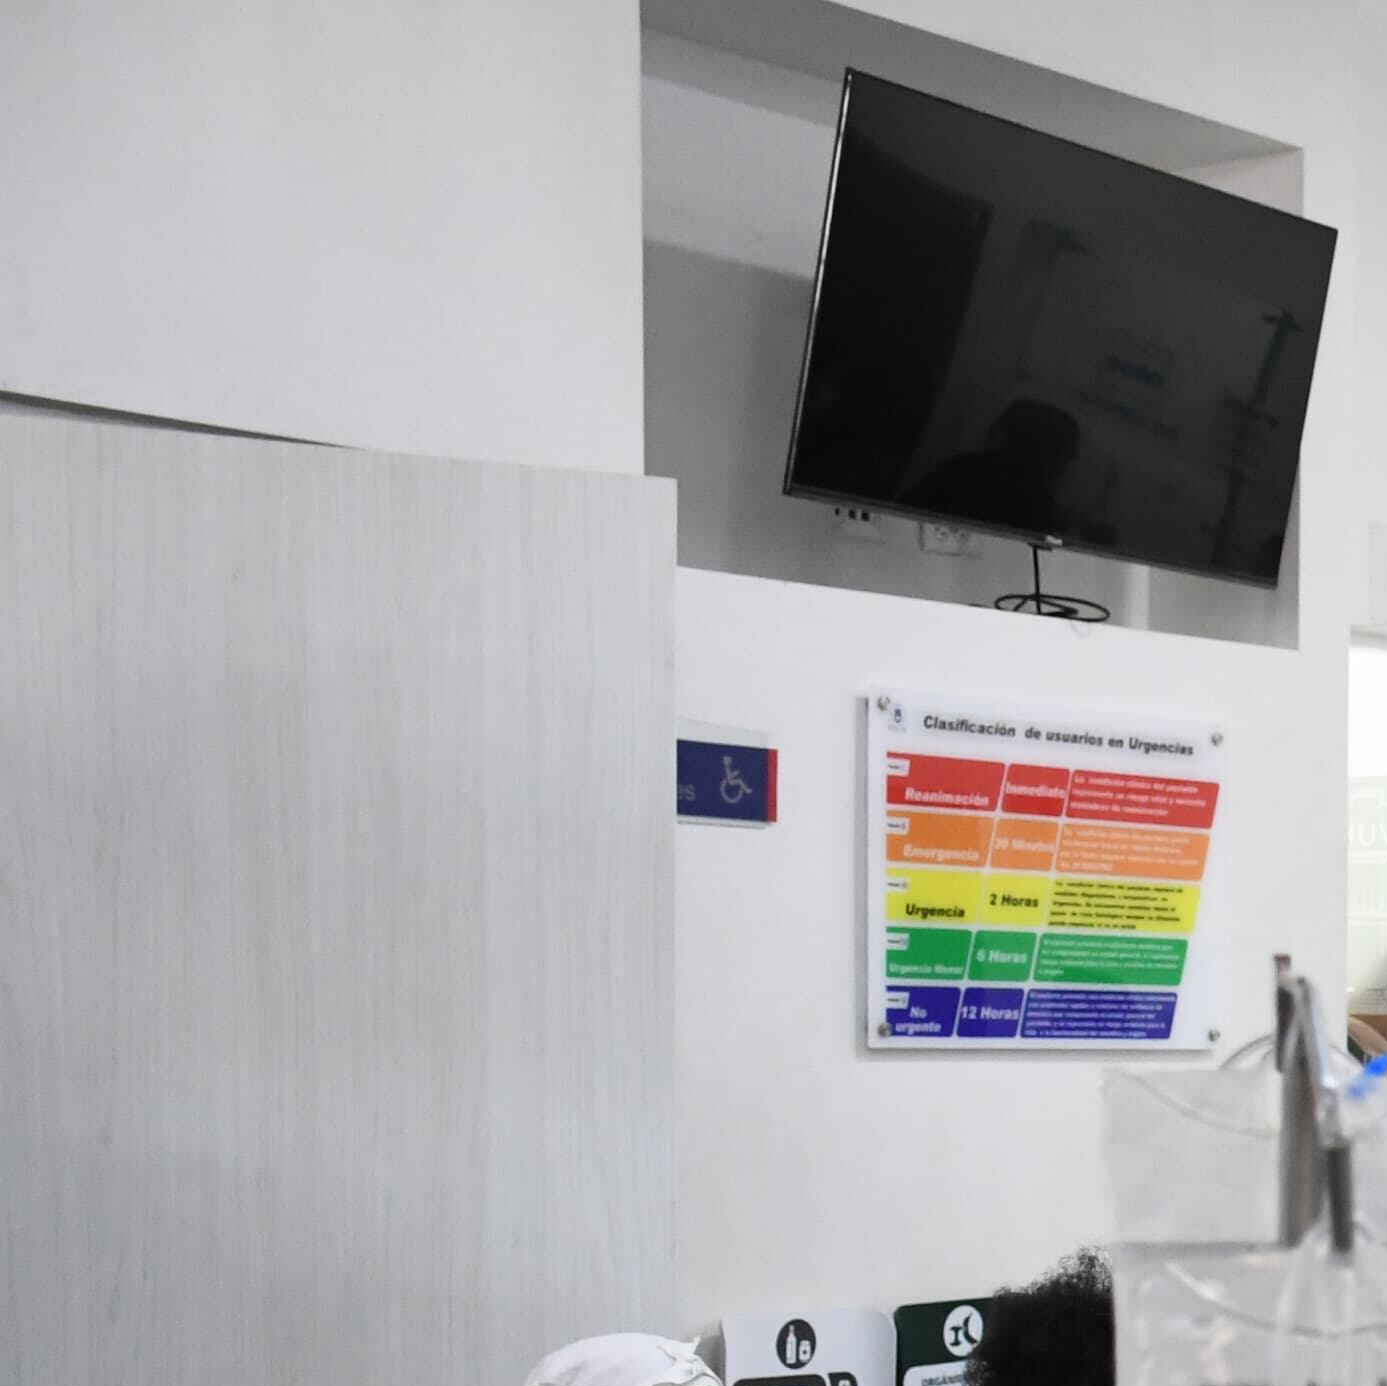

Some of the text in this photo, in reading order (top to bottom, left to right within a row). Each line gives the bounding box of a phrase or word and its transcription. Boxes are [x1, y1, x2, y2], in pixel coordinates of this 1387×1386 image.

[923, 715, 1016, 738] Clasificación
[1024, 727, 1041, 741] de
[1046, 731, 1103, 746] usuarios
[1108, 736, 1124, 748] en
[1128, 736, 1194, 756] Urgencias
[989, 893, 1040, 908] 2 Horas
[905, 904, 966, 921] Urgencia
[989, 949, 1028, 964] Horas
[962, 1006, 1019, 1021] 12 Horas
